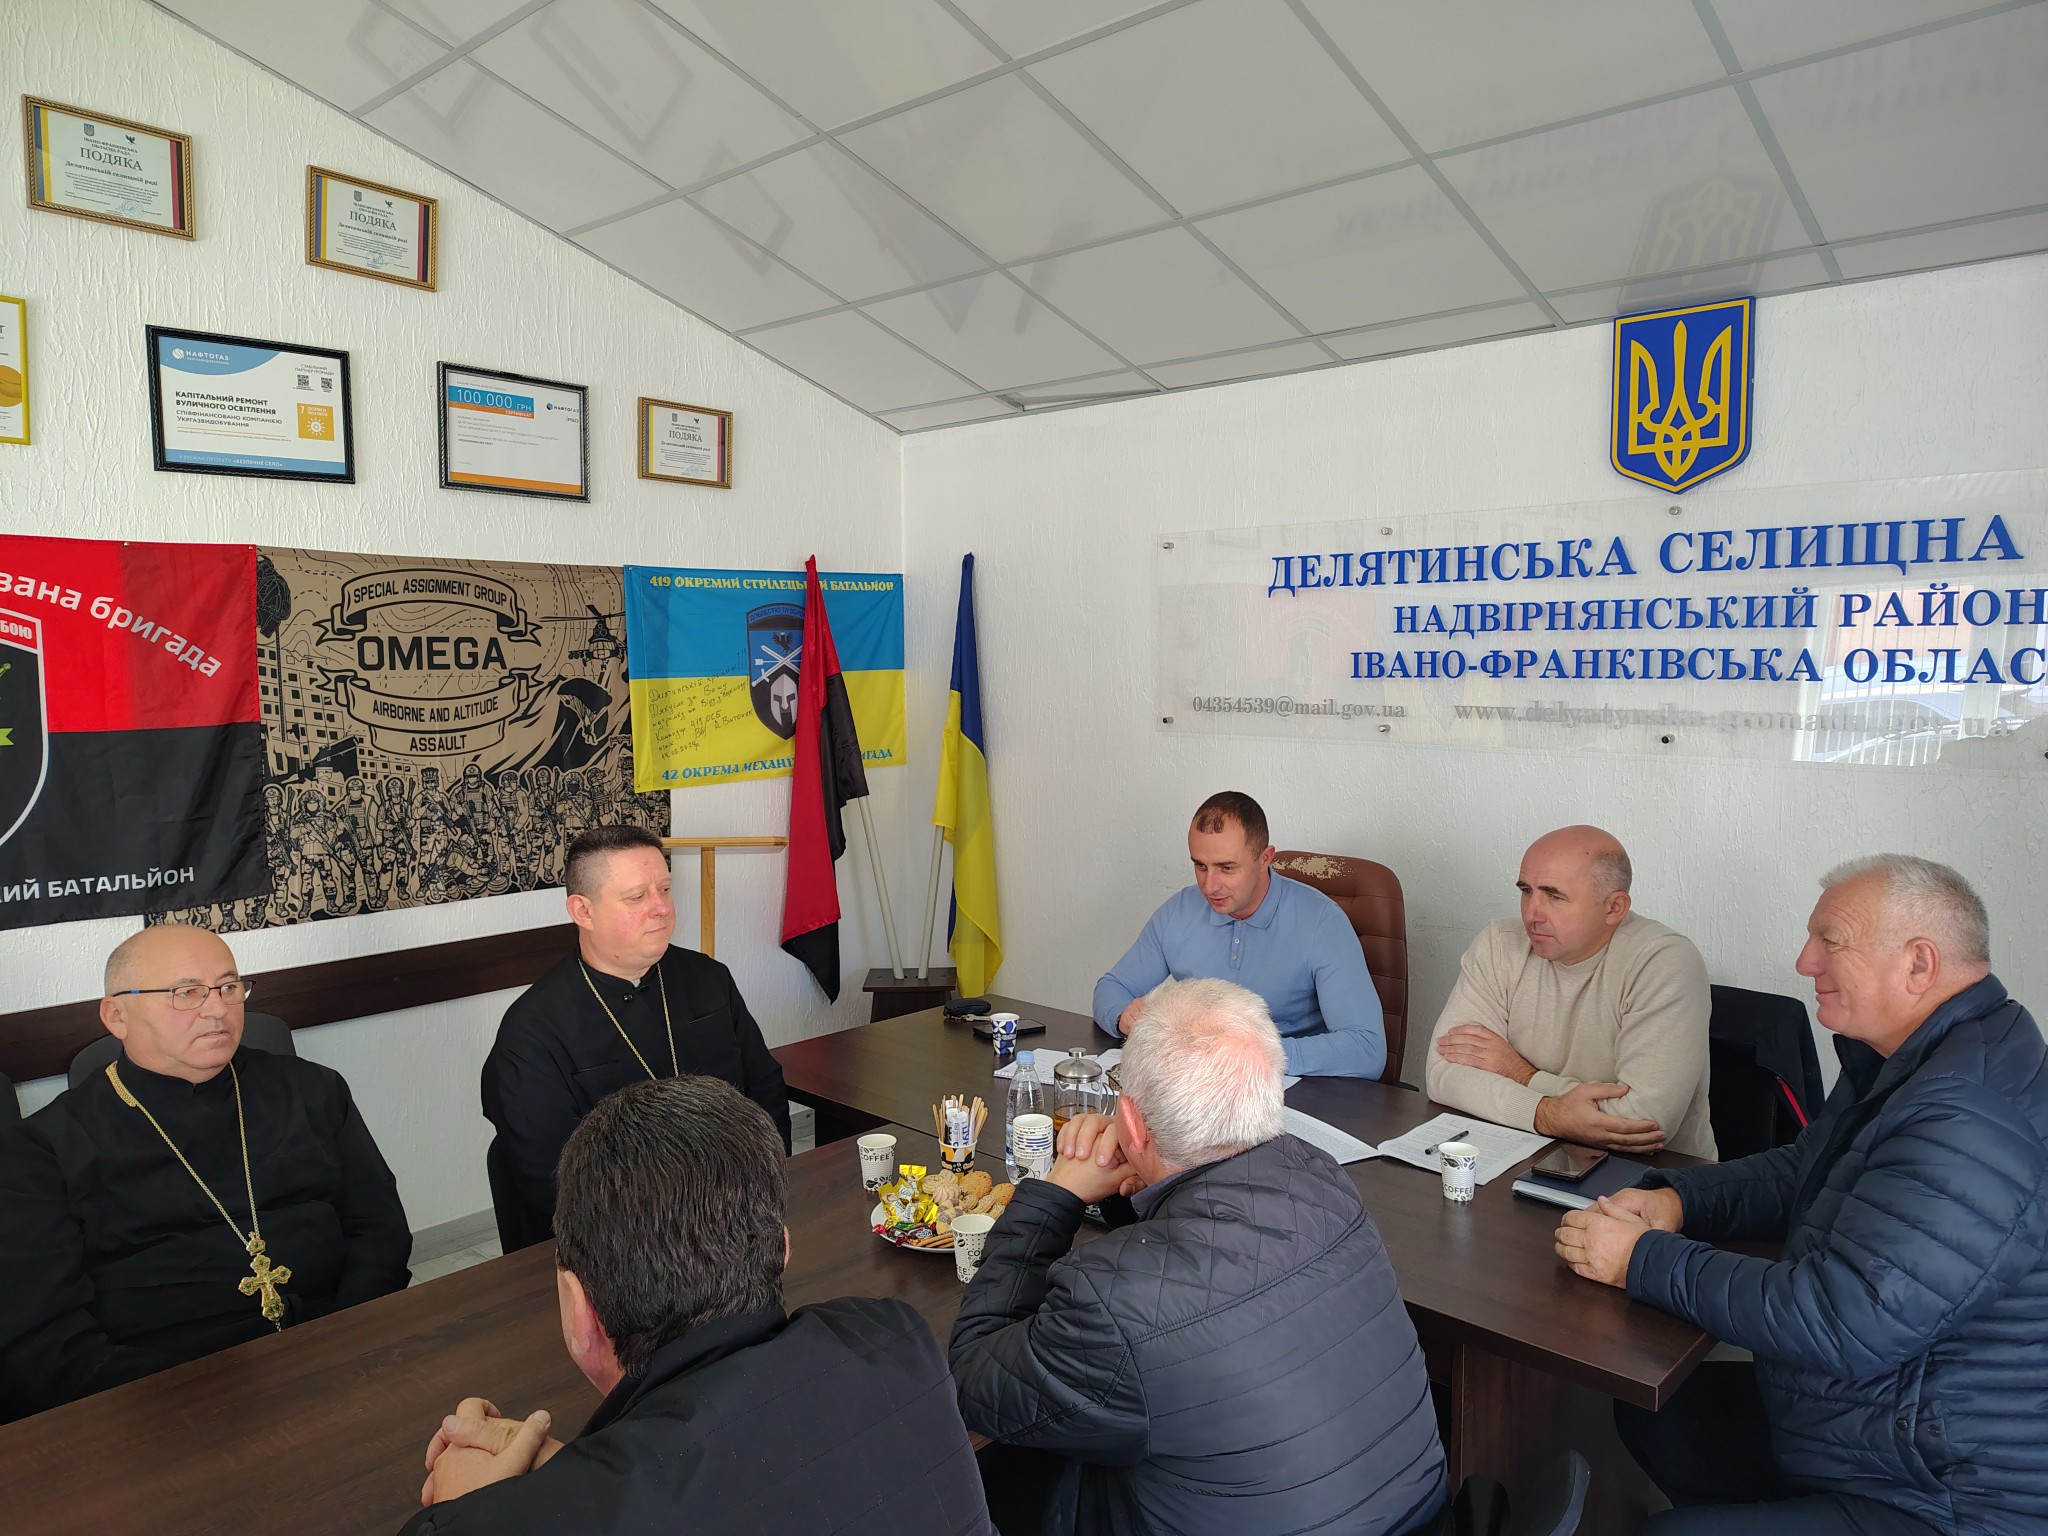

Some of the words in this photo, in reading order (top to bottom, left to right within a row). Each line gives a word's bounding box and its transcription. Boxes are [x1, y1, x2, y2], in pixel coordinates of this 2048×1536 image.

[80, 147, 143, 171] ПОДЯКА
[65, 160, 112, 175] Делятинській
[112, 172, 144, 183] селищній
[144, 178, 158, 186] раді
[350, 210, 397, 231] ПОДЯКА
[186, 350, 229, 361] НАФТОГАЗ
[175, 391, 234, 403] КАПІТАЛЬНИЙ
[235, 397, 269, 406] РЕМОНТ
[176, 399, 227, 411] ВУЛИЧНОГО
[227, 404, 277, 415] ОСВІТЛЕННЯ
[300, 405, 305, 414] 7
[457, 388, 481, 404] 100
[486, 393, 512, 409] 000
[516, 403, 532, 412] ГРН
[176, 410, 241, 421] СПІВФІНАНСОВАНО
[242, 416, 282, 425] КОМПАНІЄЮ
[669, 430, 703, 443] ПОДЯКА
[1268, 537, 1637, 598] ДЕЛЯТИНСЬКА
[1659, 514, 2024, 576] СЕЛИЩНА
[354, 580, 399, 603] SPECIAL
[403, 578, 471, 596] ASSIGNMENT
[474, 585, 507, 606] GROUP
[650, 576, 671, 587] 419
[674, 576, 741, 589] ОКРЕМИЙ
[830, 581, 894, 592] БАТАЛЬЙОН
[1393, 587, 1819, 640] НАДВІРНЯНСЬКИЙ
[1838, 582, 2048, 628] РАЙОН
[90, 596, 222, 677] бригада
[357, 636, 507, 670] OMEGA
[1350, 647, 1823, 683] ІВАНО-ФРАНКІВСЬКА
[373, 699, 425, 722] AIRBORNE
[429, 708, 450, 722] AND
[454, 696, 498, 721] ALTITUDE
[690, 718, 703, 729] 419
[705, 710, 722, 723] ОСБ
[1192, 696, 1407, 720] 04354539@mail.gov.ua
[410, 735, 467, 752] ASSAULT
[661, 769, 678, 780] 42
[682, 764, 739, 779] ОКРЕМА
[742, 756, 794, 772] МЕХАНІ
[0, 878, 40, 903] ИЙ
[48, 866, 195, 898] БАТАЛЬЙОН
